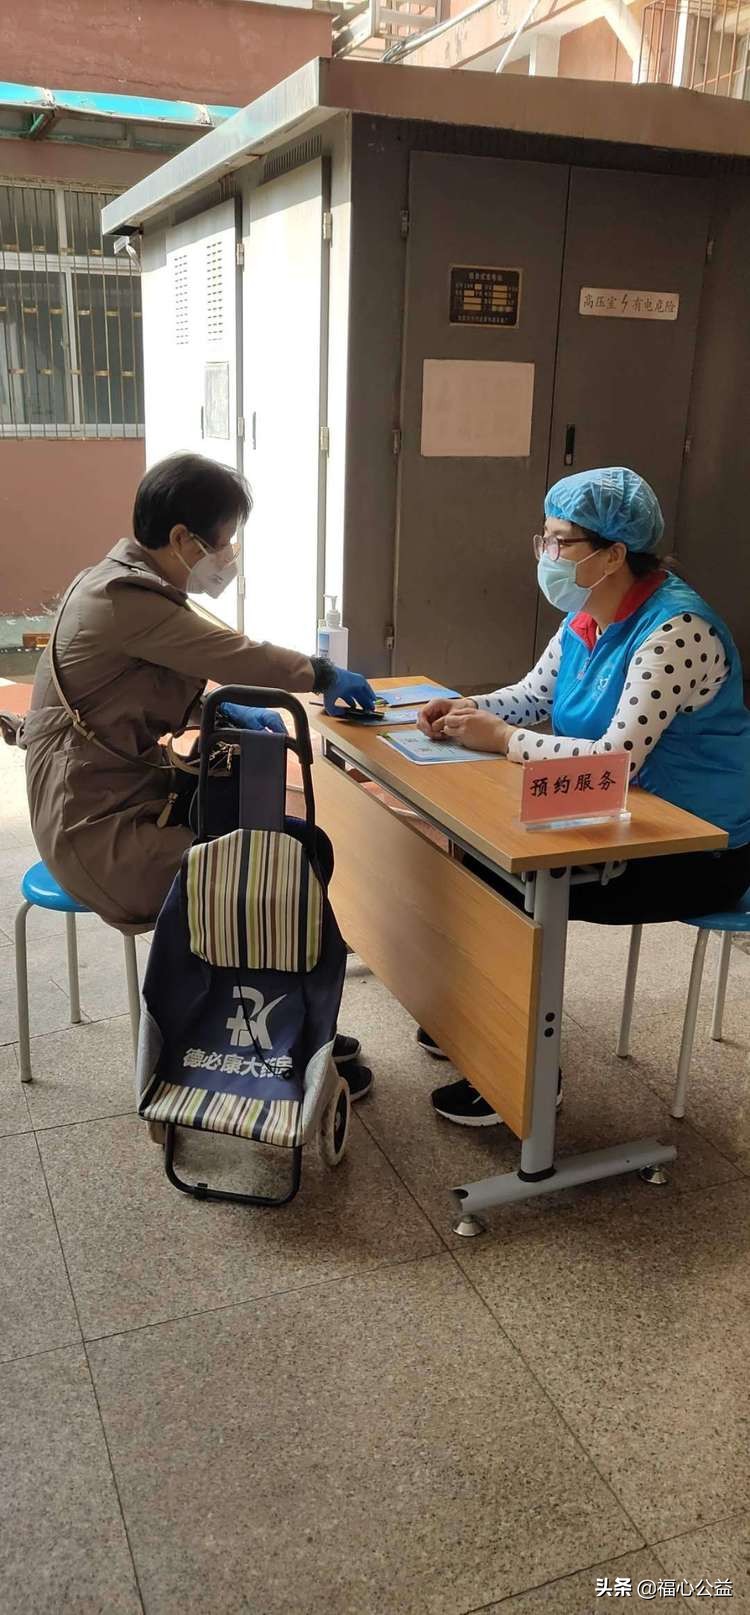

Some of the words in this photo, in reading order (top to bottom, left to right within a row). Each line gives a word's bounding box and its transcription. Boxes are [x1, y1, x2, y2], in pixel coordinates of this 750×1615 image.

[583, 294, 617, 309] 高压室
[631, 296, 676, 312] 有电危险
[530, 771, 616, 797] 预约服务
